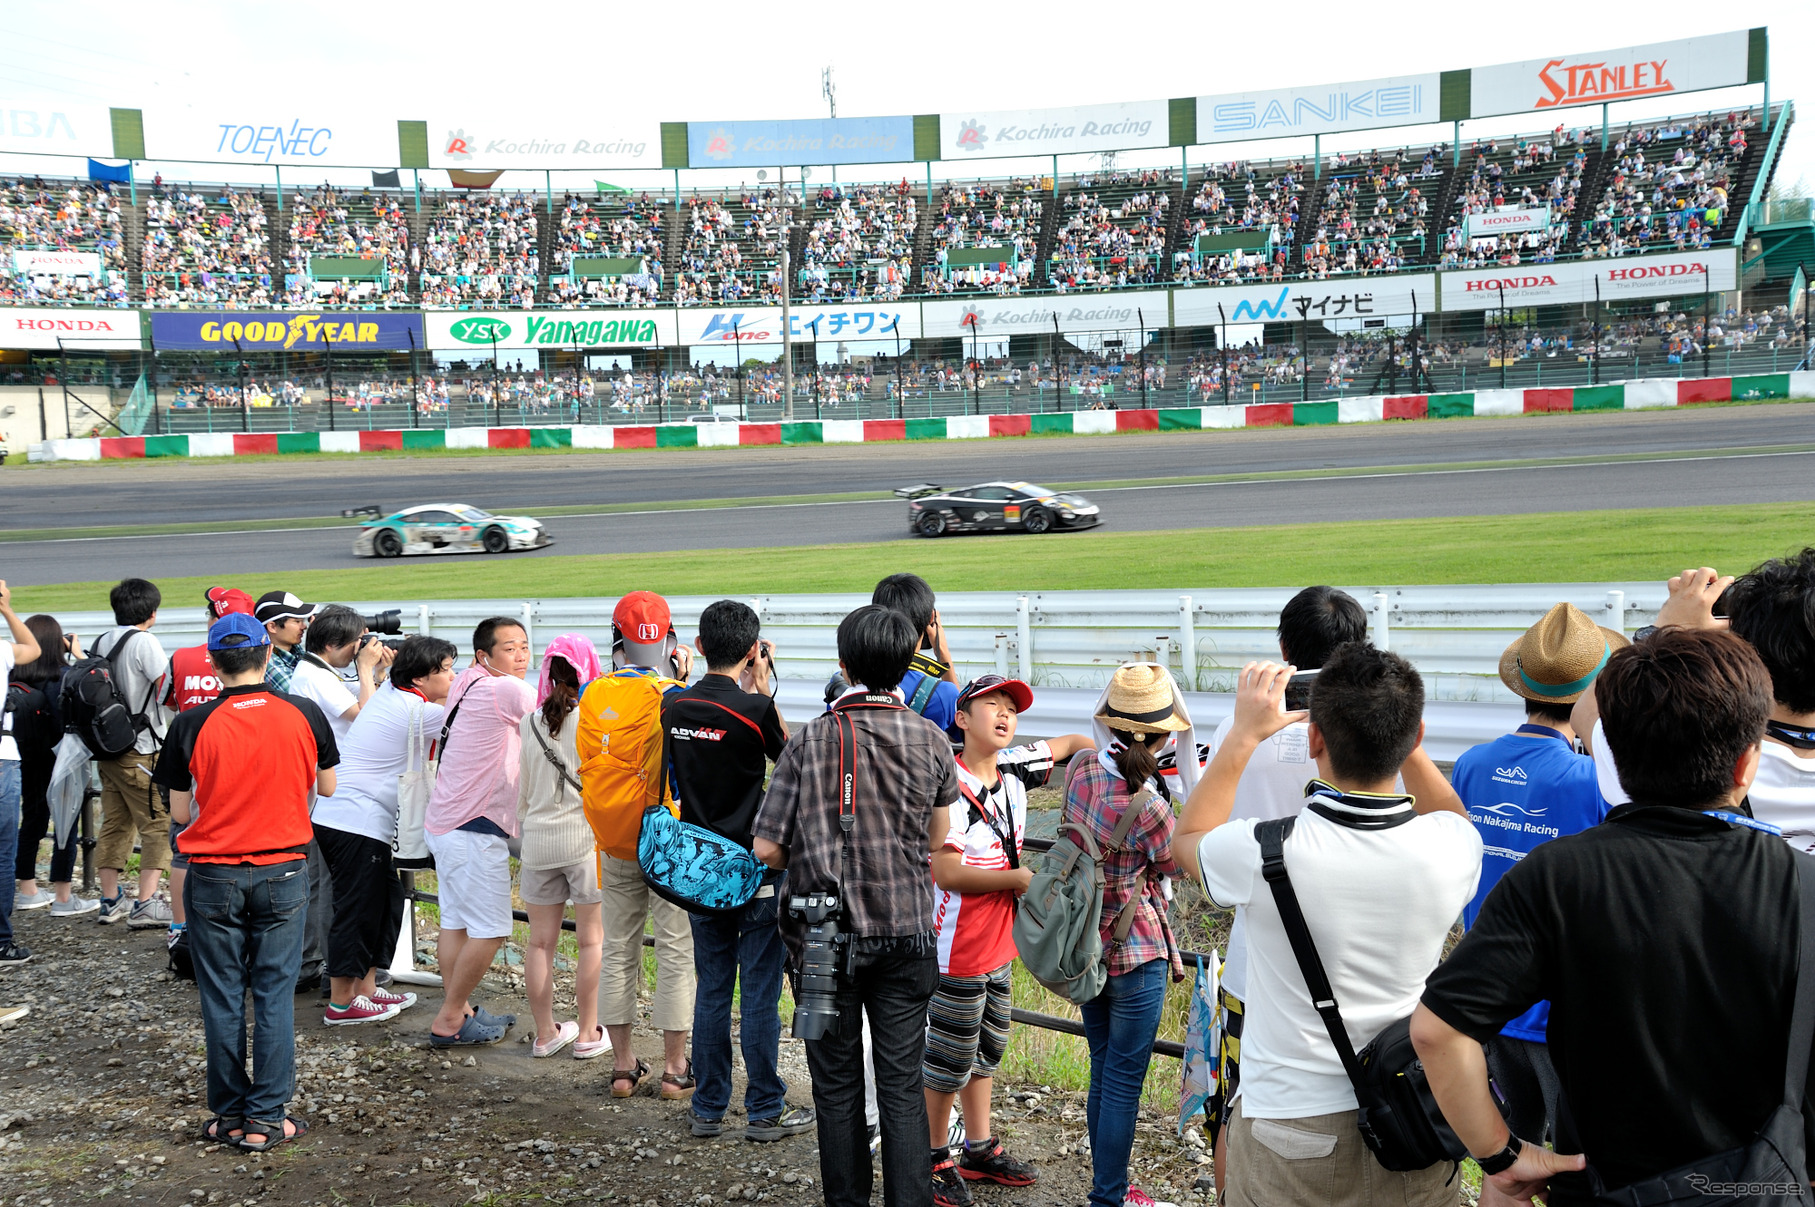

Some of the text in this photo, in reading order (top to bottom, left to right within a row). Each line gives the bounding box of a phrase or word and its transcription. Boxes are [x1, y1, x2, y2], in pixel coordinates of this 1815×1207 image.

[1534, 58, 1675, 108] STANLEY
[1214, 84, 1422, 132] SANKEI
[995, 123, 1076, 142] Kochira
[1081, 117, 1152, 137] Racing
[217, 118, 332, 162] TOENEC
[484, 139, 566, 154] Kochira
[572, 138, 646, 158] Racing
[742, 134, 823, 151] Kochira
[828, 131, 898, 151] Racing
[1483, 215, 1532, 225] HONDA
[32, 257, 84, 265] HONDA
[1607, 262, 1707, 281] HONDA
[1465, 275, 1558, 292] HONDA
[1292, 292, 1374, 316] マイナビ
[16, 319, 114, 331] HONDA
[779, 312, 901, 336] エイチワン
[992, 308, 1063, 325] Kochira
[1067, 306, 1132, 323] Racing
[461, 322, 507, 339] YSK
[524, 316, 655, 345] Yanagawa
[232, 698, 268, 708] HONDA
[866, 694, 893, 704] Canon
[671, 727, 721, 741] ADVAN
[844, 772, 853, 805] Canon
[1524, 822, 1559, 838] Racing
